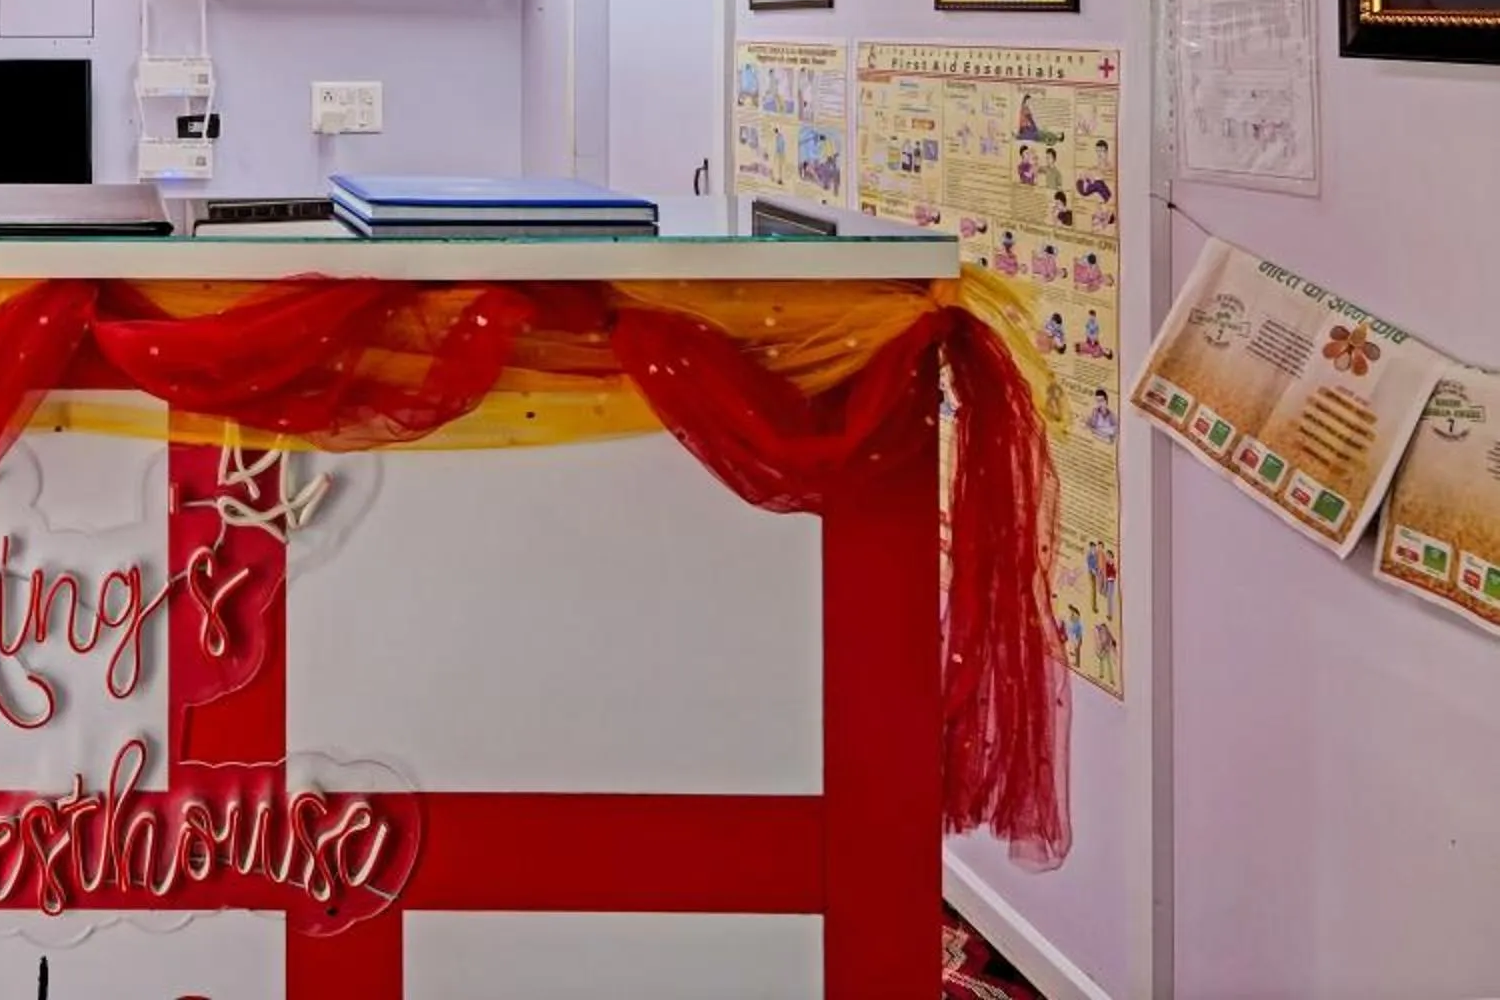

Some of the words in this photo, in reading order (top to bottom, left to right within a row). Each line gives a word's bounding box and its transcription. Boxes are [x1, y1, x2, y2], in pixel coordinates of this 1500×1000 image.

[891, 58, 928, 71] First
[932, 61, 958, 74] Aid
[962, 61, 1066, 79] Essentials
